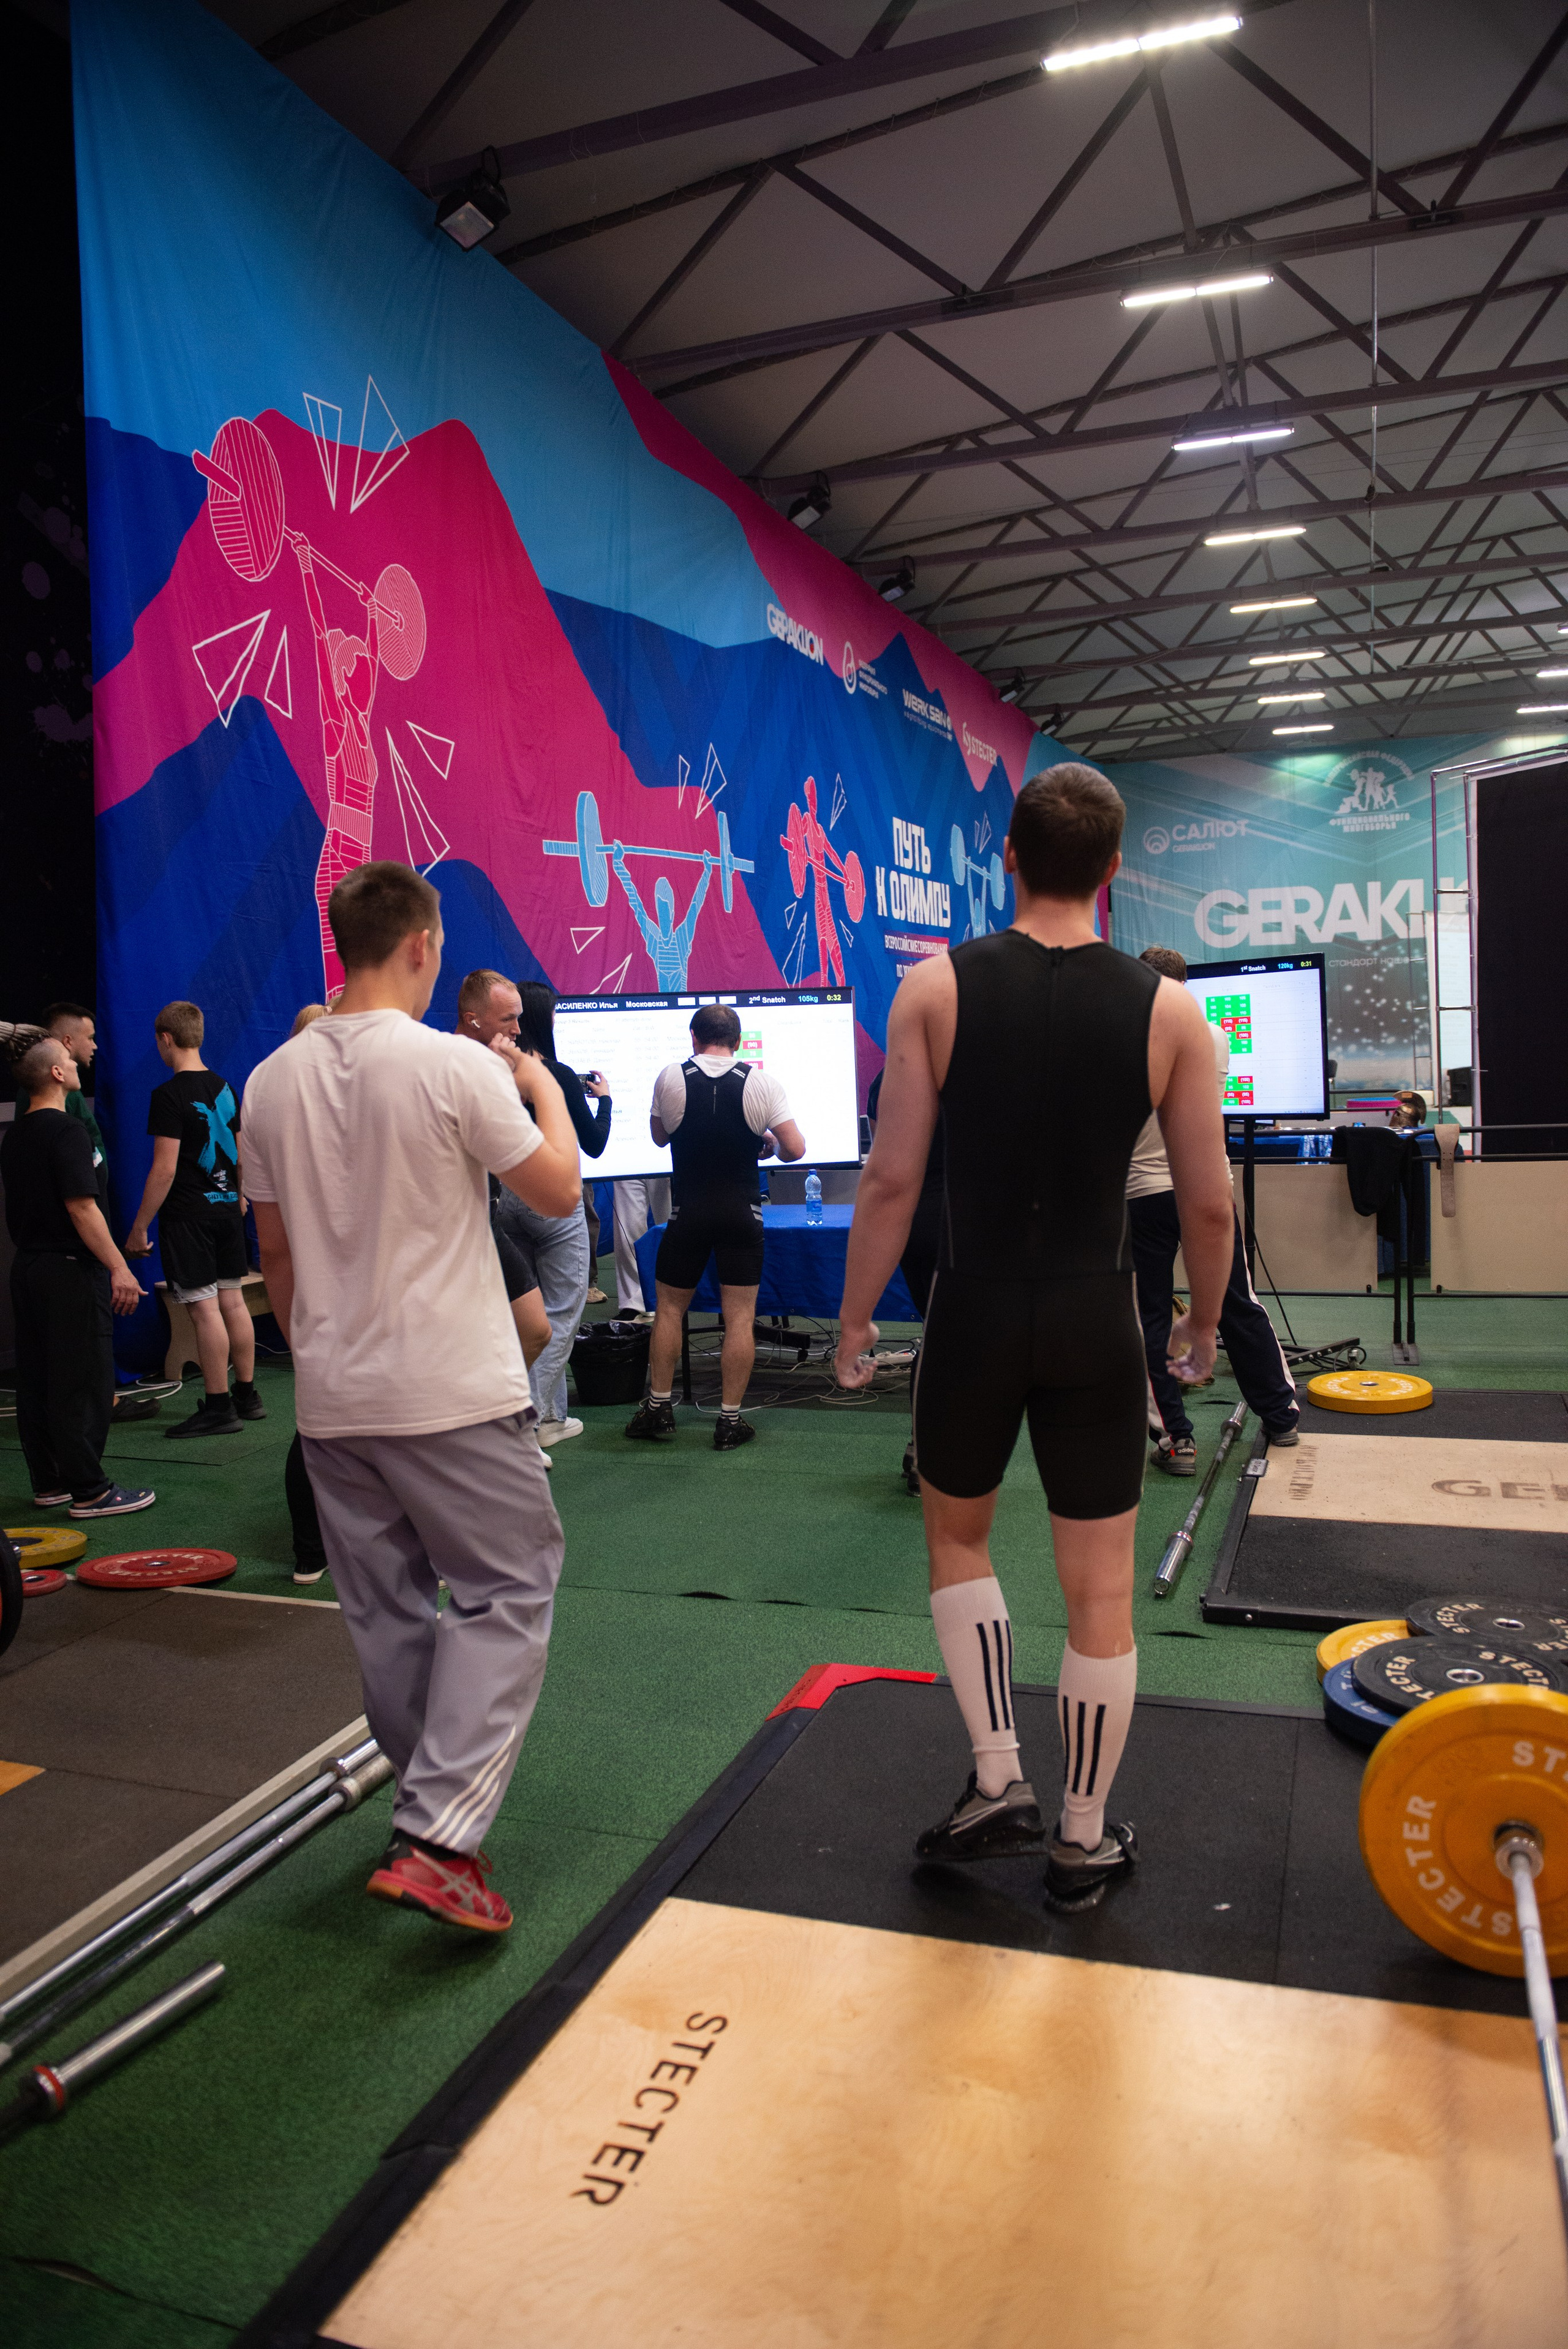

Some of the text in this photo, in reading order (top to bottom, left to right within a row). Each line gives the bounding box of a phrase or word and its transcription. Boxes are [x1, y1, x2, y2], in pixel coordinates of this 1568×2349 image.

[892, 816, 931, 874] ПУТЬ
[1172, 819, 1249, 842] САЛЮТ
[876, 865, 951, 928] К ОЛИМПУ
[1329, 957, 1378, 968] стандарт
[1431, 1479, 1568, 1501] GE
[1436, 1602, 1485, 1634] STECTER
[1512, 1740, 1568, 1781] ST
[1402, 1795, 1513, 1936] STECTER
[568, 2011, 729, 2206] STECTER
